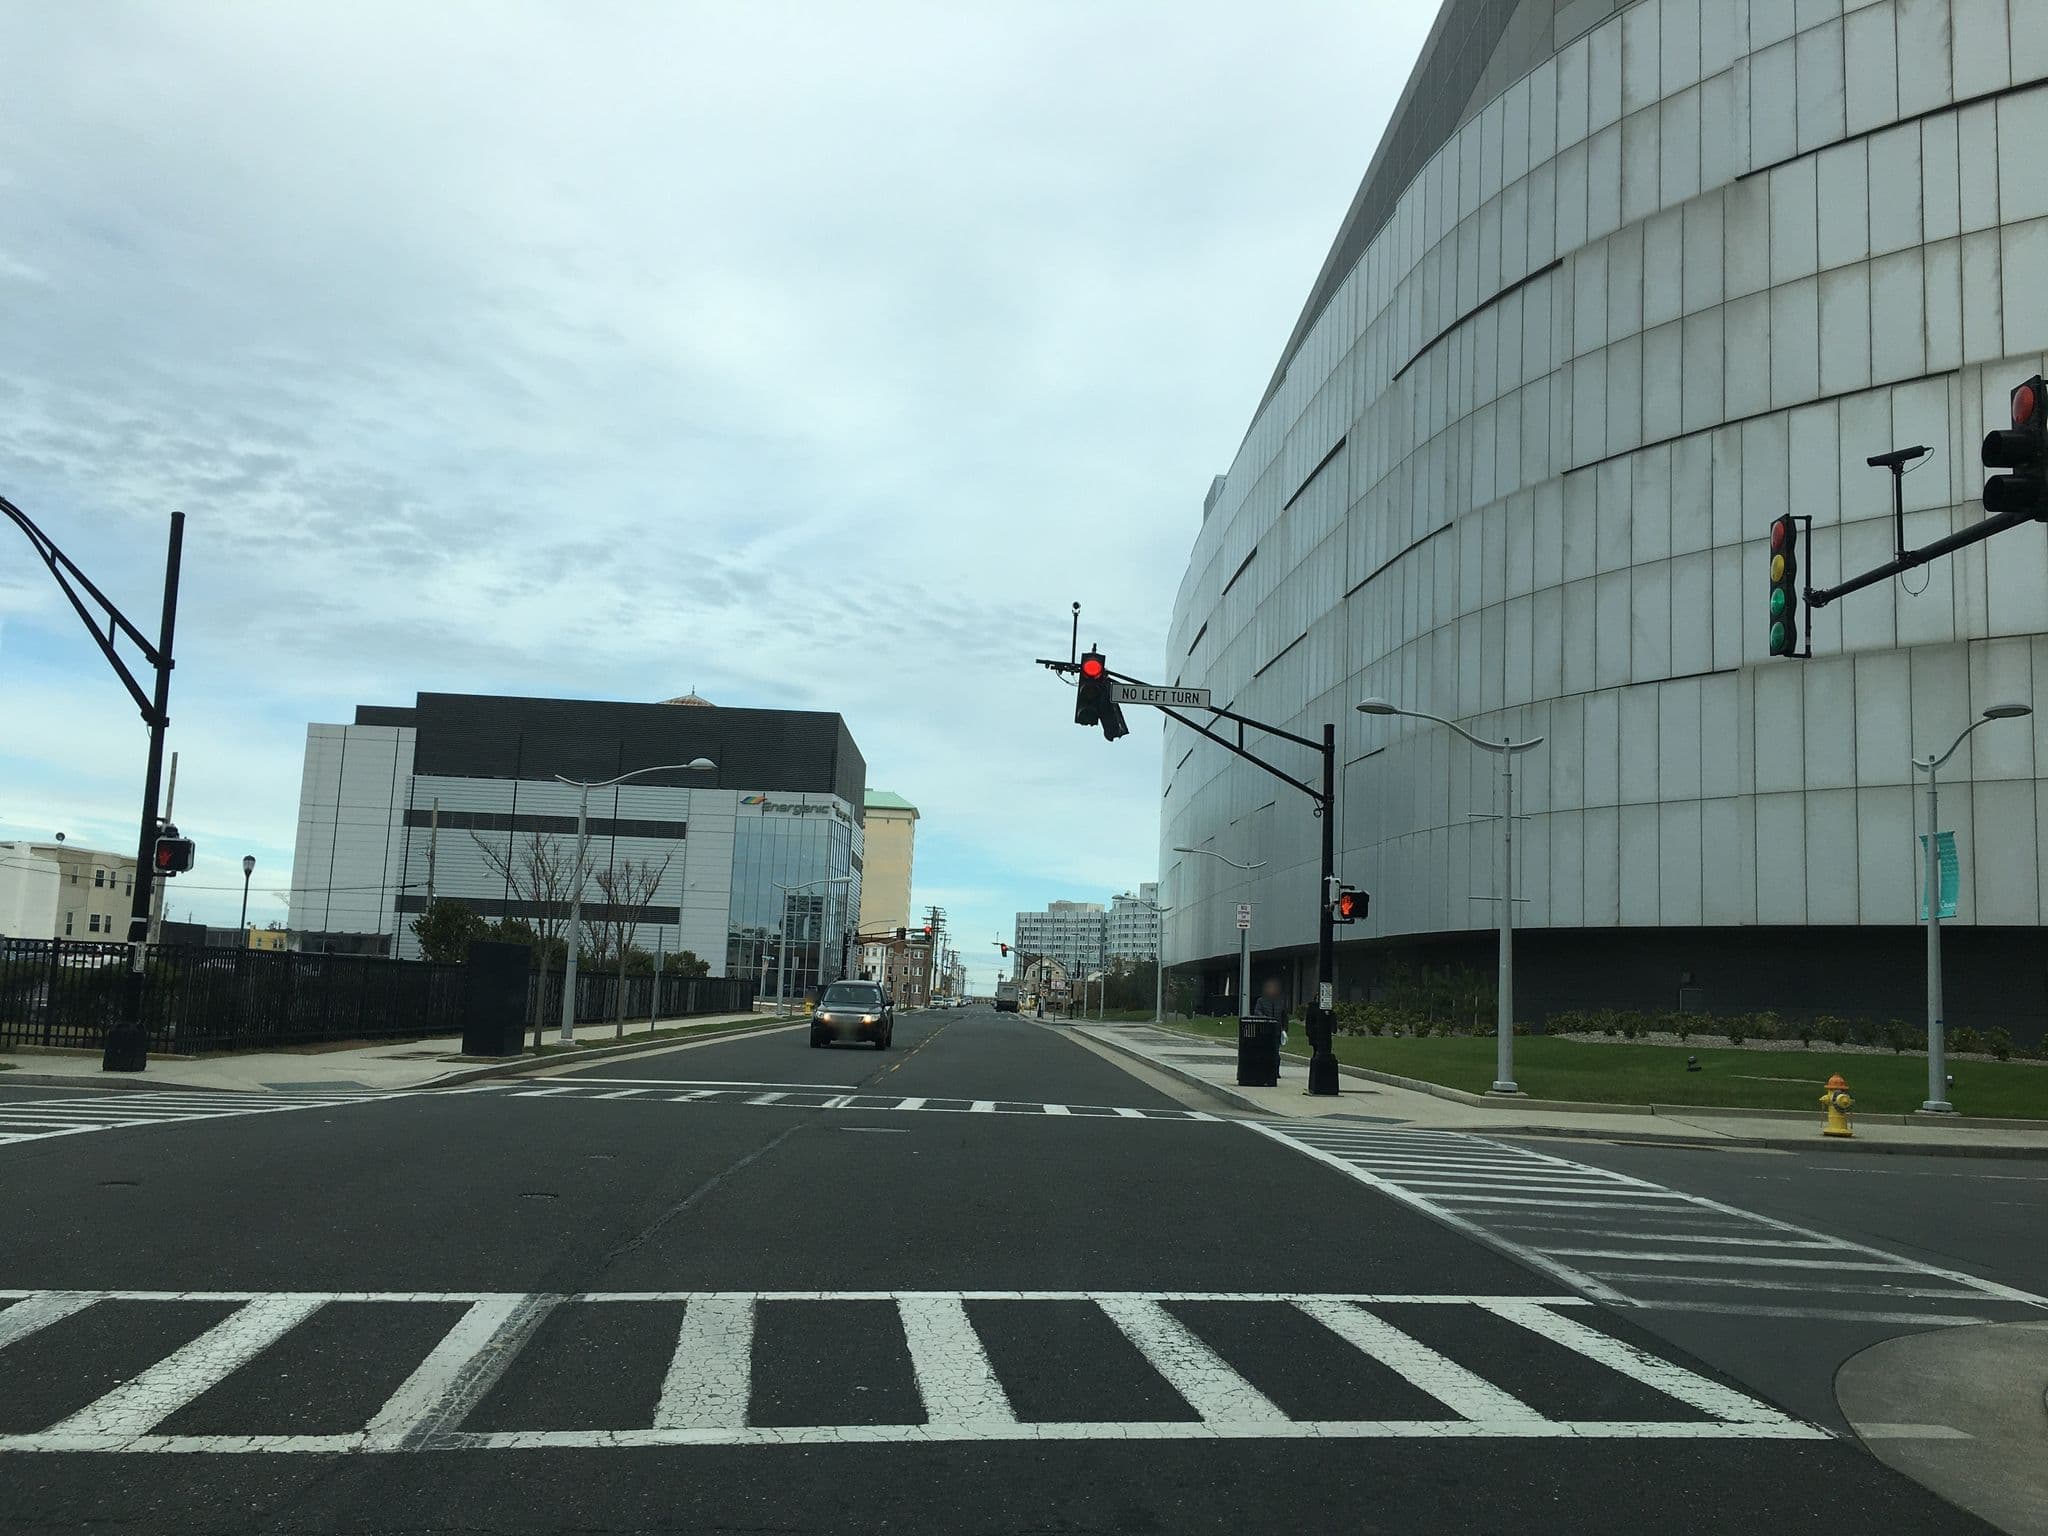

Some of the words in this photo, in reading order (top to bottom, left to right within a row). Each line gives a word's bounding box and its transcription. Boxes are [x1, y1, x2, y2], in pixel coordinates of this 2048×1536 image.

[1121, 687, 1137, 700] NO
[1141, 689, 1167, 702] LEFT
[1171, 691, 1200, 704] TURN
